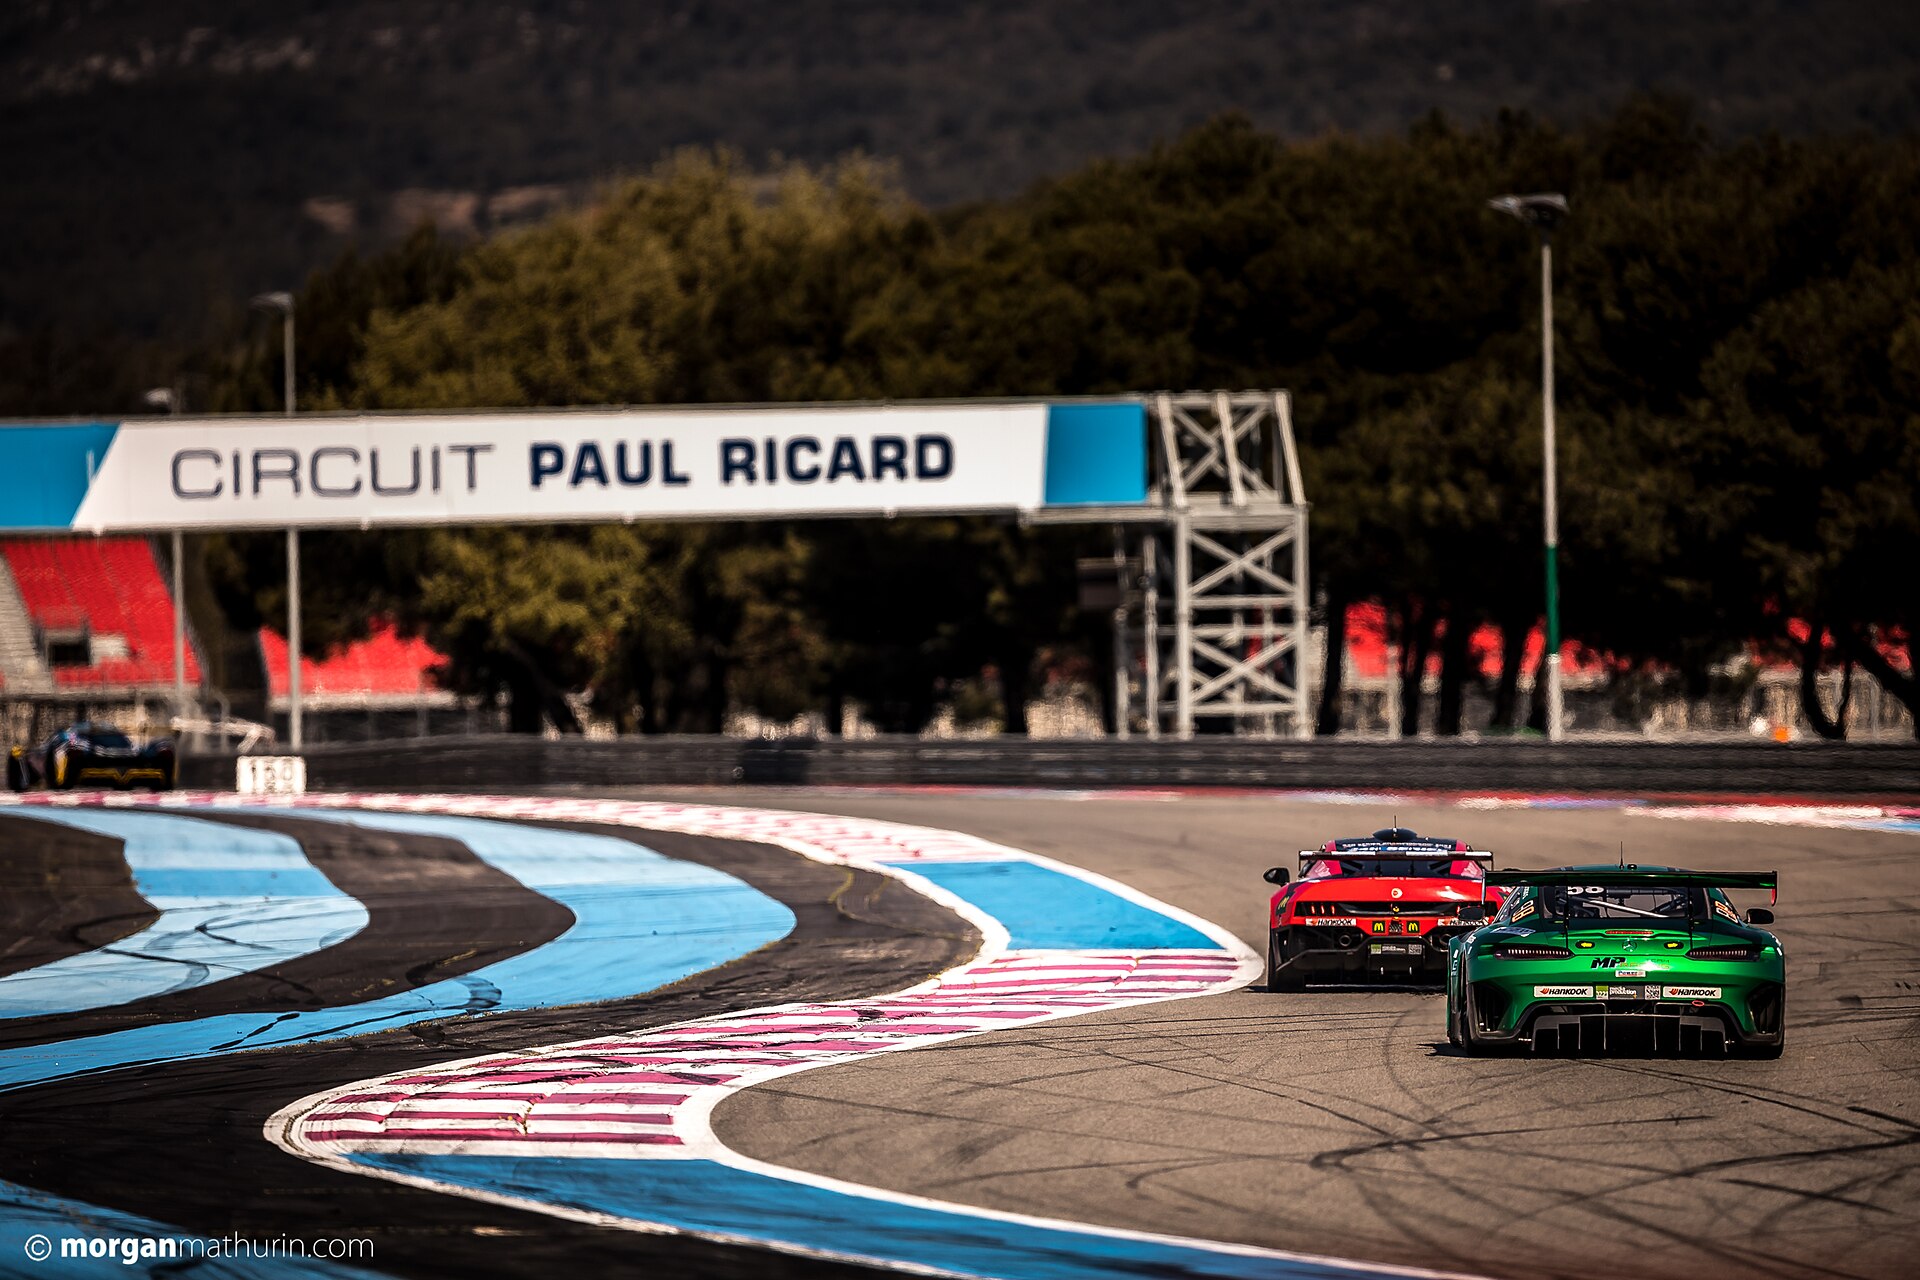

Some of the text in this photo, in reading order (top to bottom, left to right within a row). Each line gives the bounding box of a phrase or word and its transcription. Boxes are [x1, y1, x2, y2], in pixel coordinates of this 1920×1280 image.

[172, 433, 955, 500] CIRCUIT PAUL RICARD
[1591, 957, 1626, 969] MP
